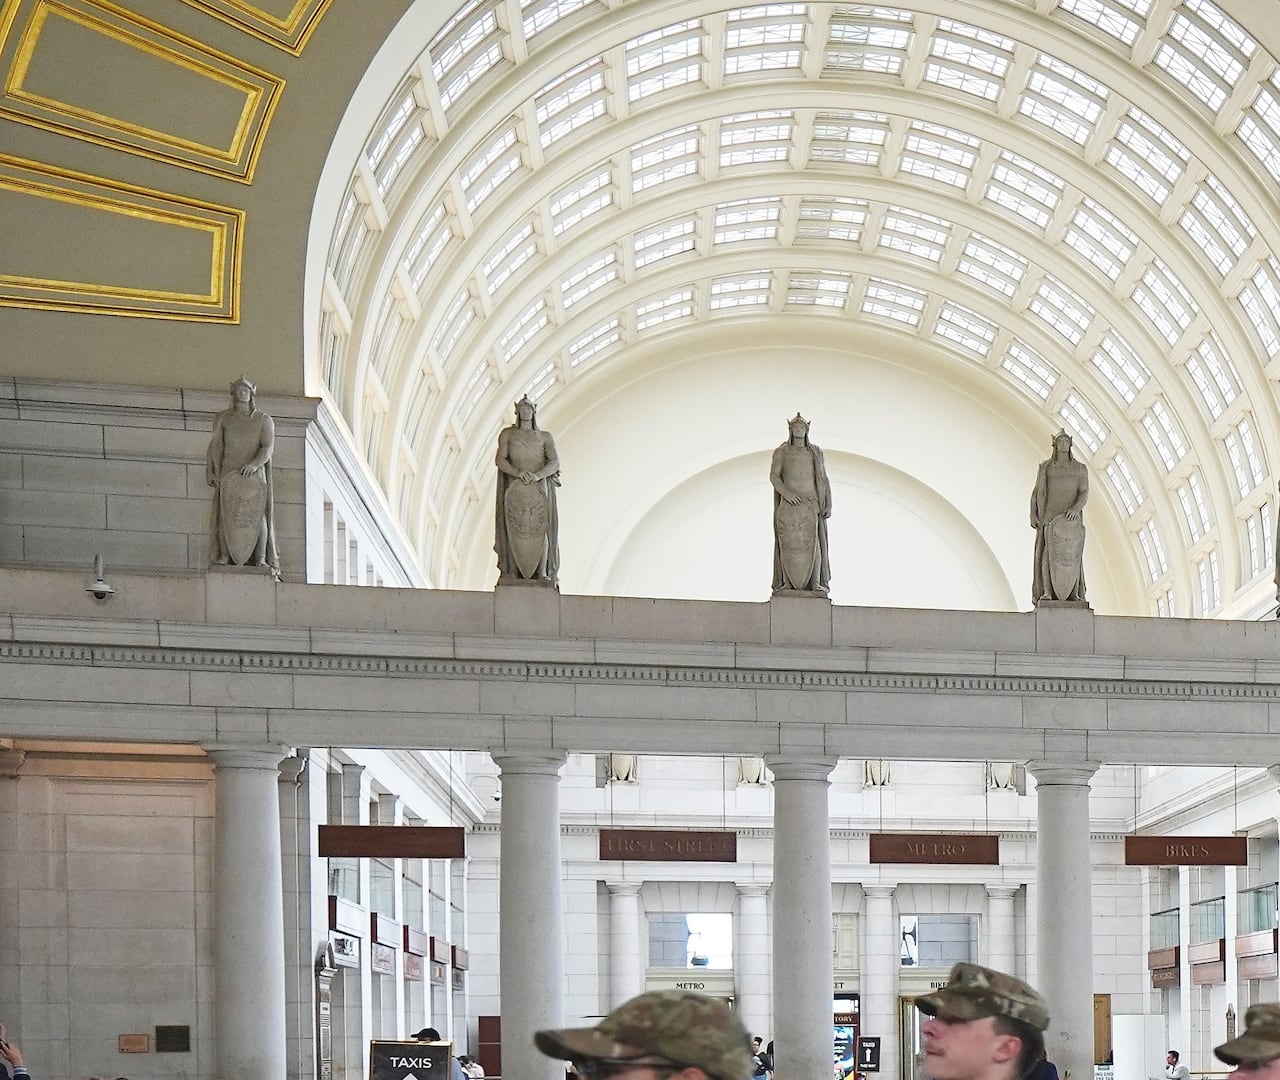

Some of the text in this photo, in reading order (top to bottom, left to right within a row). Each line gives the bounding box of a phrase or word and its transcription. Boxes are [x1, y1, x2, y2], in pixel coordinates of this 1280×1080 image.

[906, 842, 965, 856] METRO
[1165, 844, 1209, 857] BIKES
[675, 982, 705, 990] METRO
[930, 981, 949, 989] BIKE
[389, 1056, 432, 1069] TAXIS
